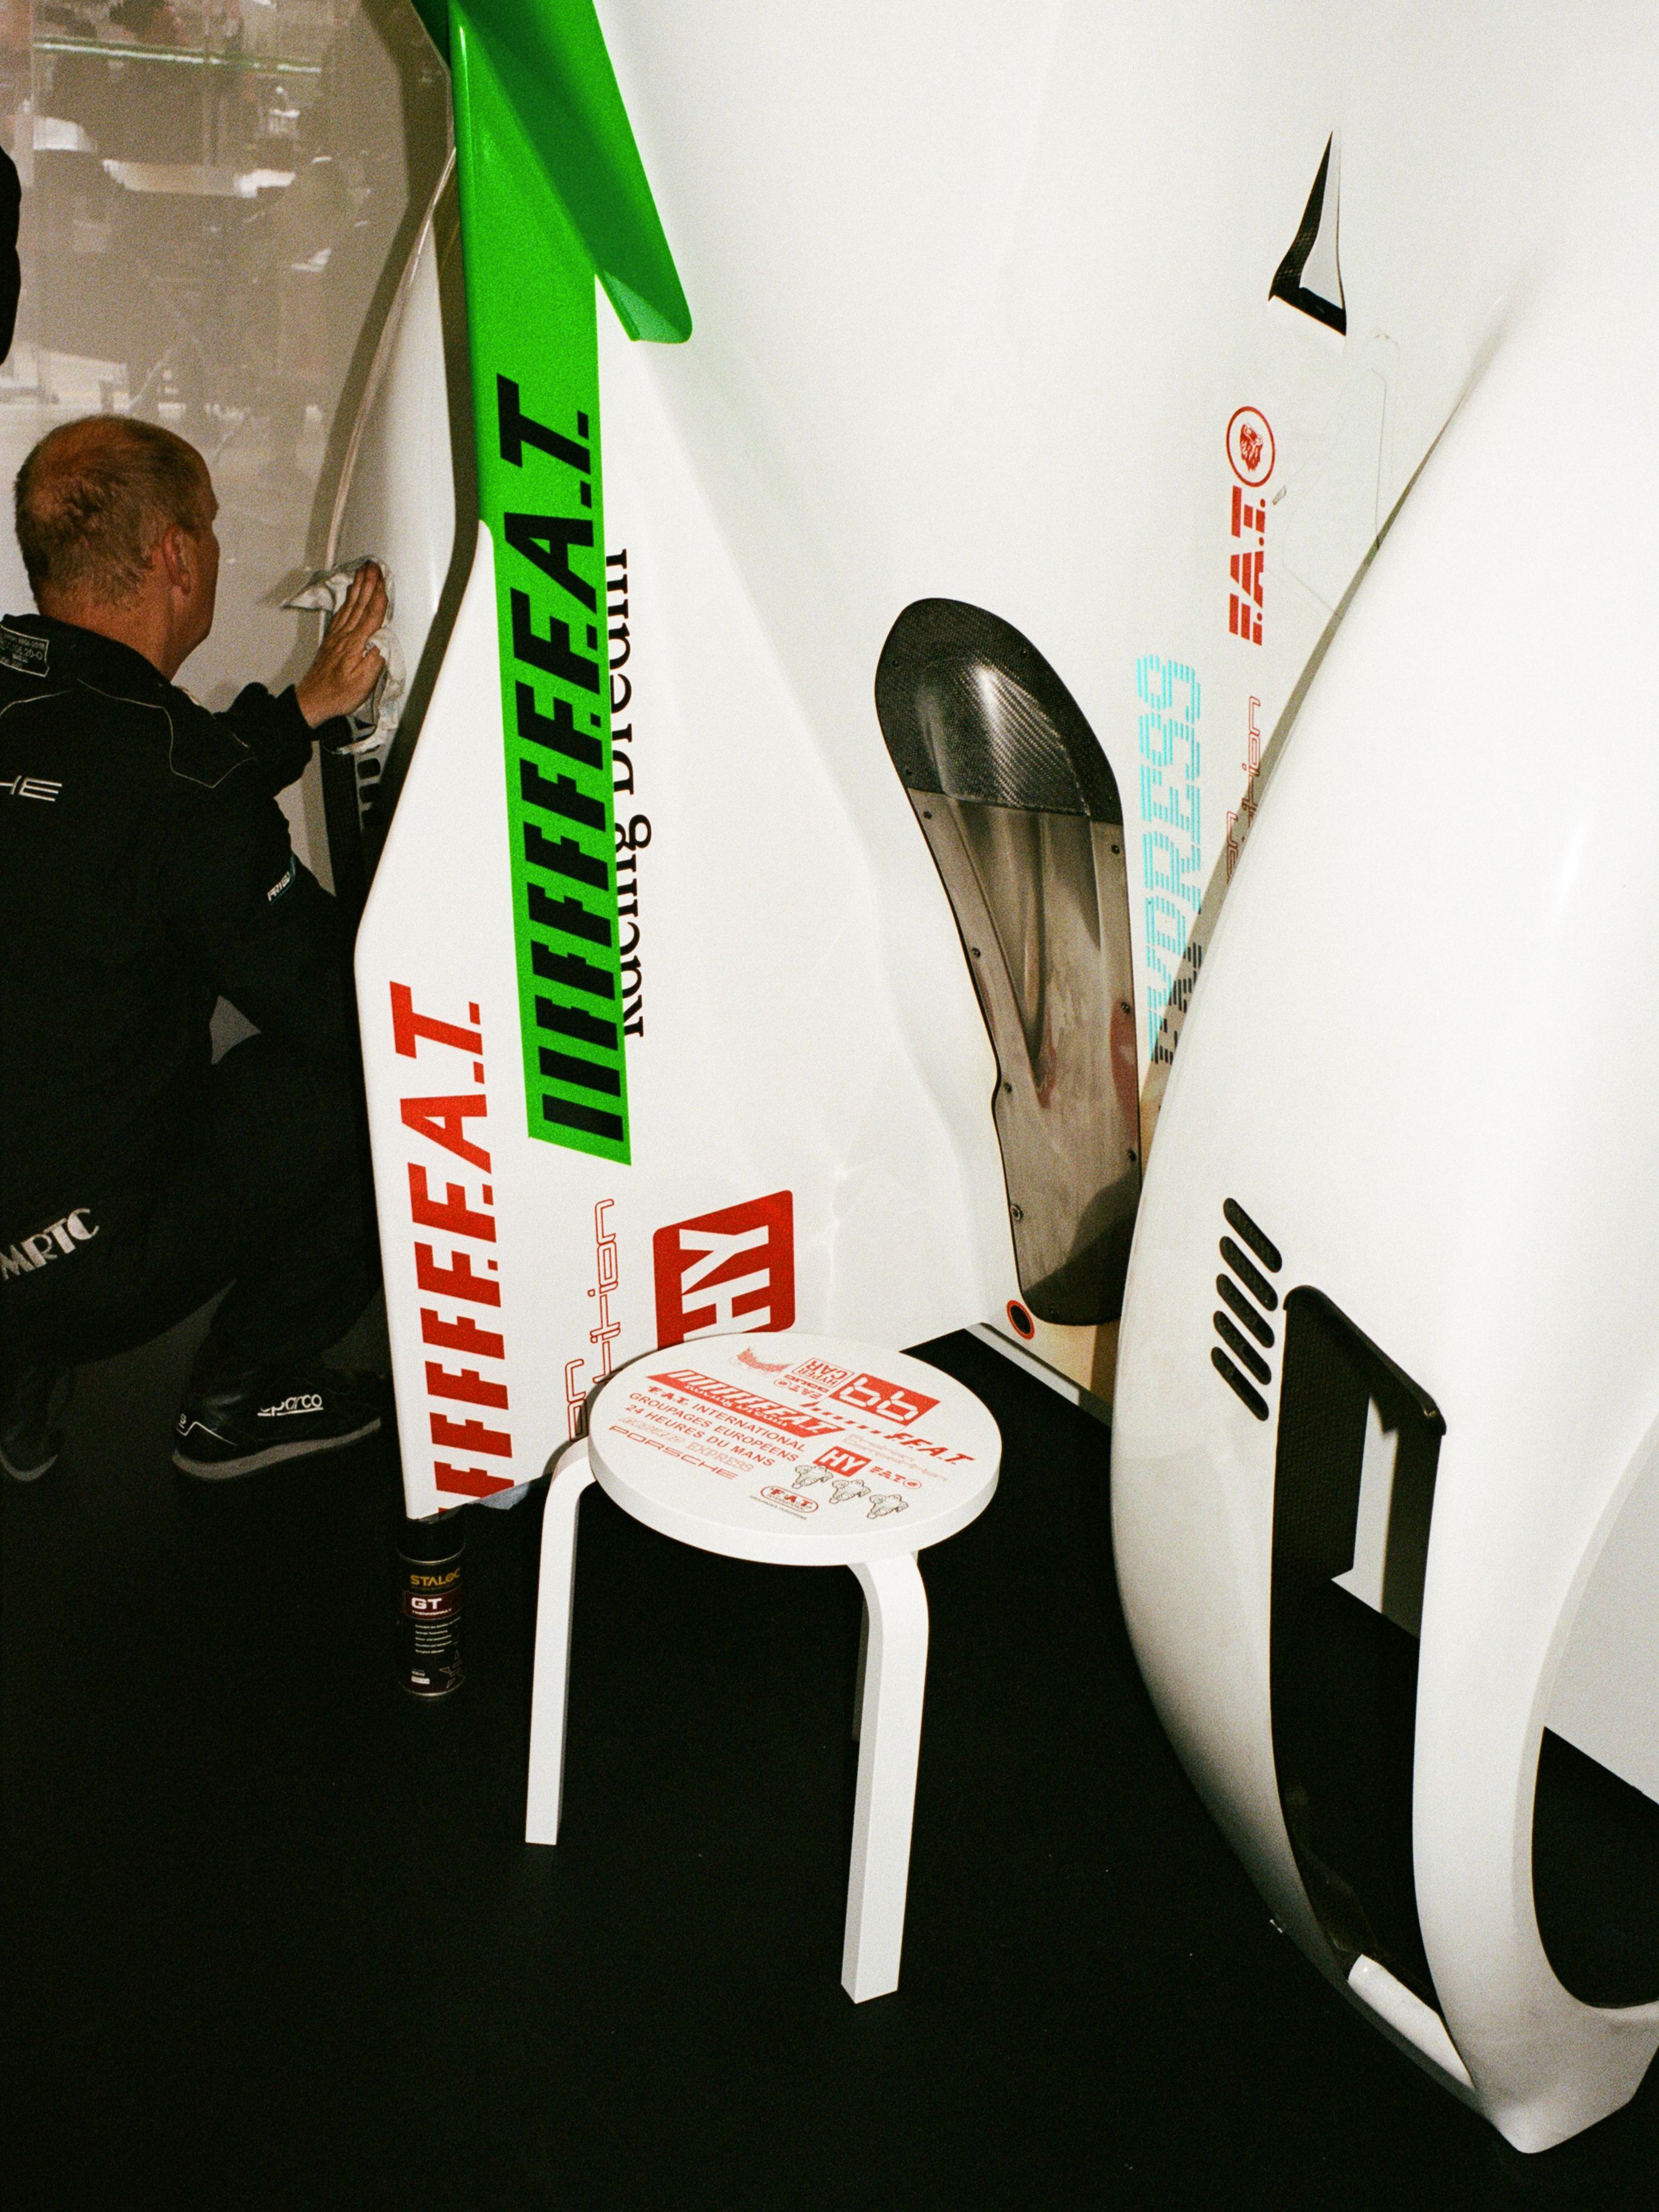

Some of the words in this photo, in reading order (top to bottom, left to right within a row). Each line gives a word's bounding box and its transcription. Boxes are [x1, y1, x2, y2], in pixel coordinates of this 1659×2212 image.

[679, 1224, 771, 1342] HY
[797, 1368, 838, 1386] HYPER
[805, 1360, 848, 1380] CAR
[625, 1403, 645, 1416] 24
[645, 1411, 705, 1439] HEURES
[706, 1434, 728, 1449] DU
[731, 1444, 775, 1468] MANS
[629, 1392, 713, 1428] GROUPAGES
[714, 1425, 800, 1463] EUROPÉENS
[692, 1403, 806, 1452] INTERNATIONAL
[608, 1425, 740, 1480] PORSCHE
[819, 1446, 864, 1473] HY
[410, 1566, 461, 1586] STALOC
[411, 1597, 442, 1610] GT
